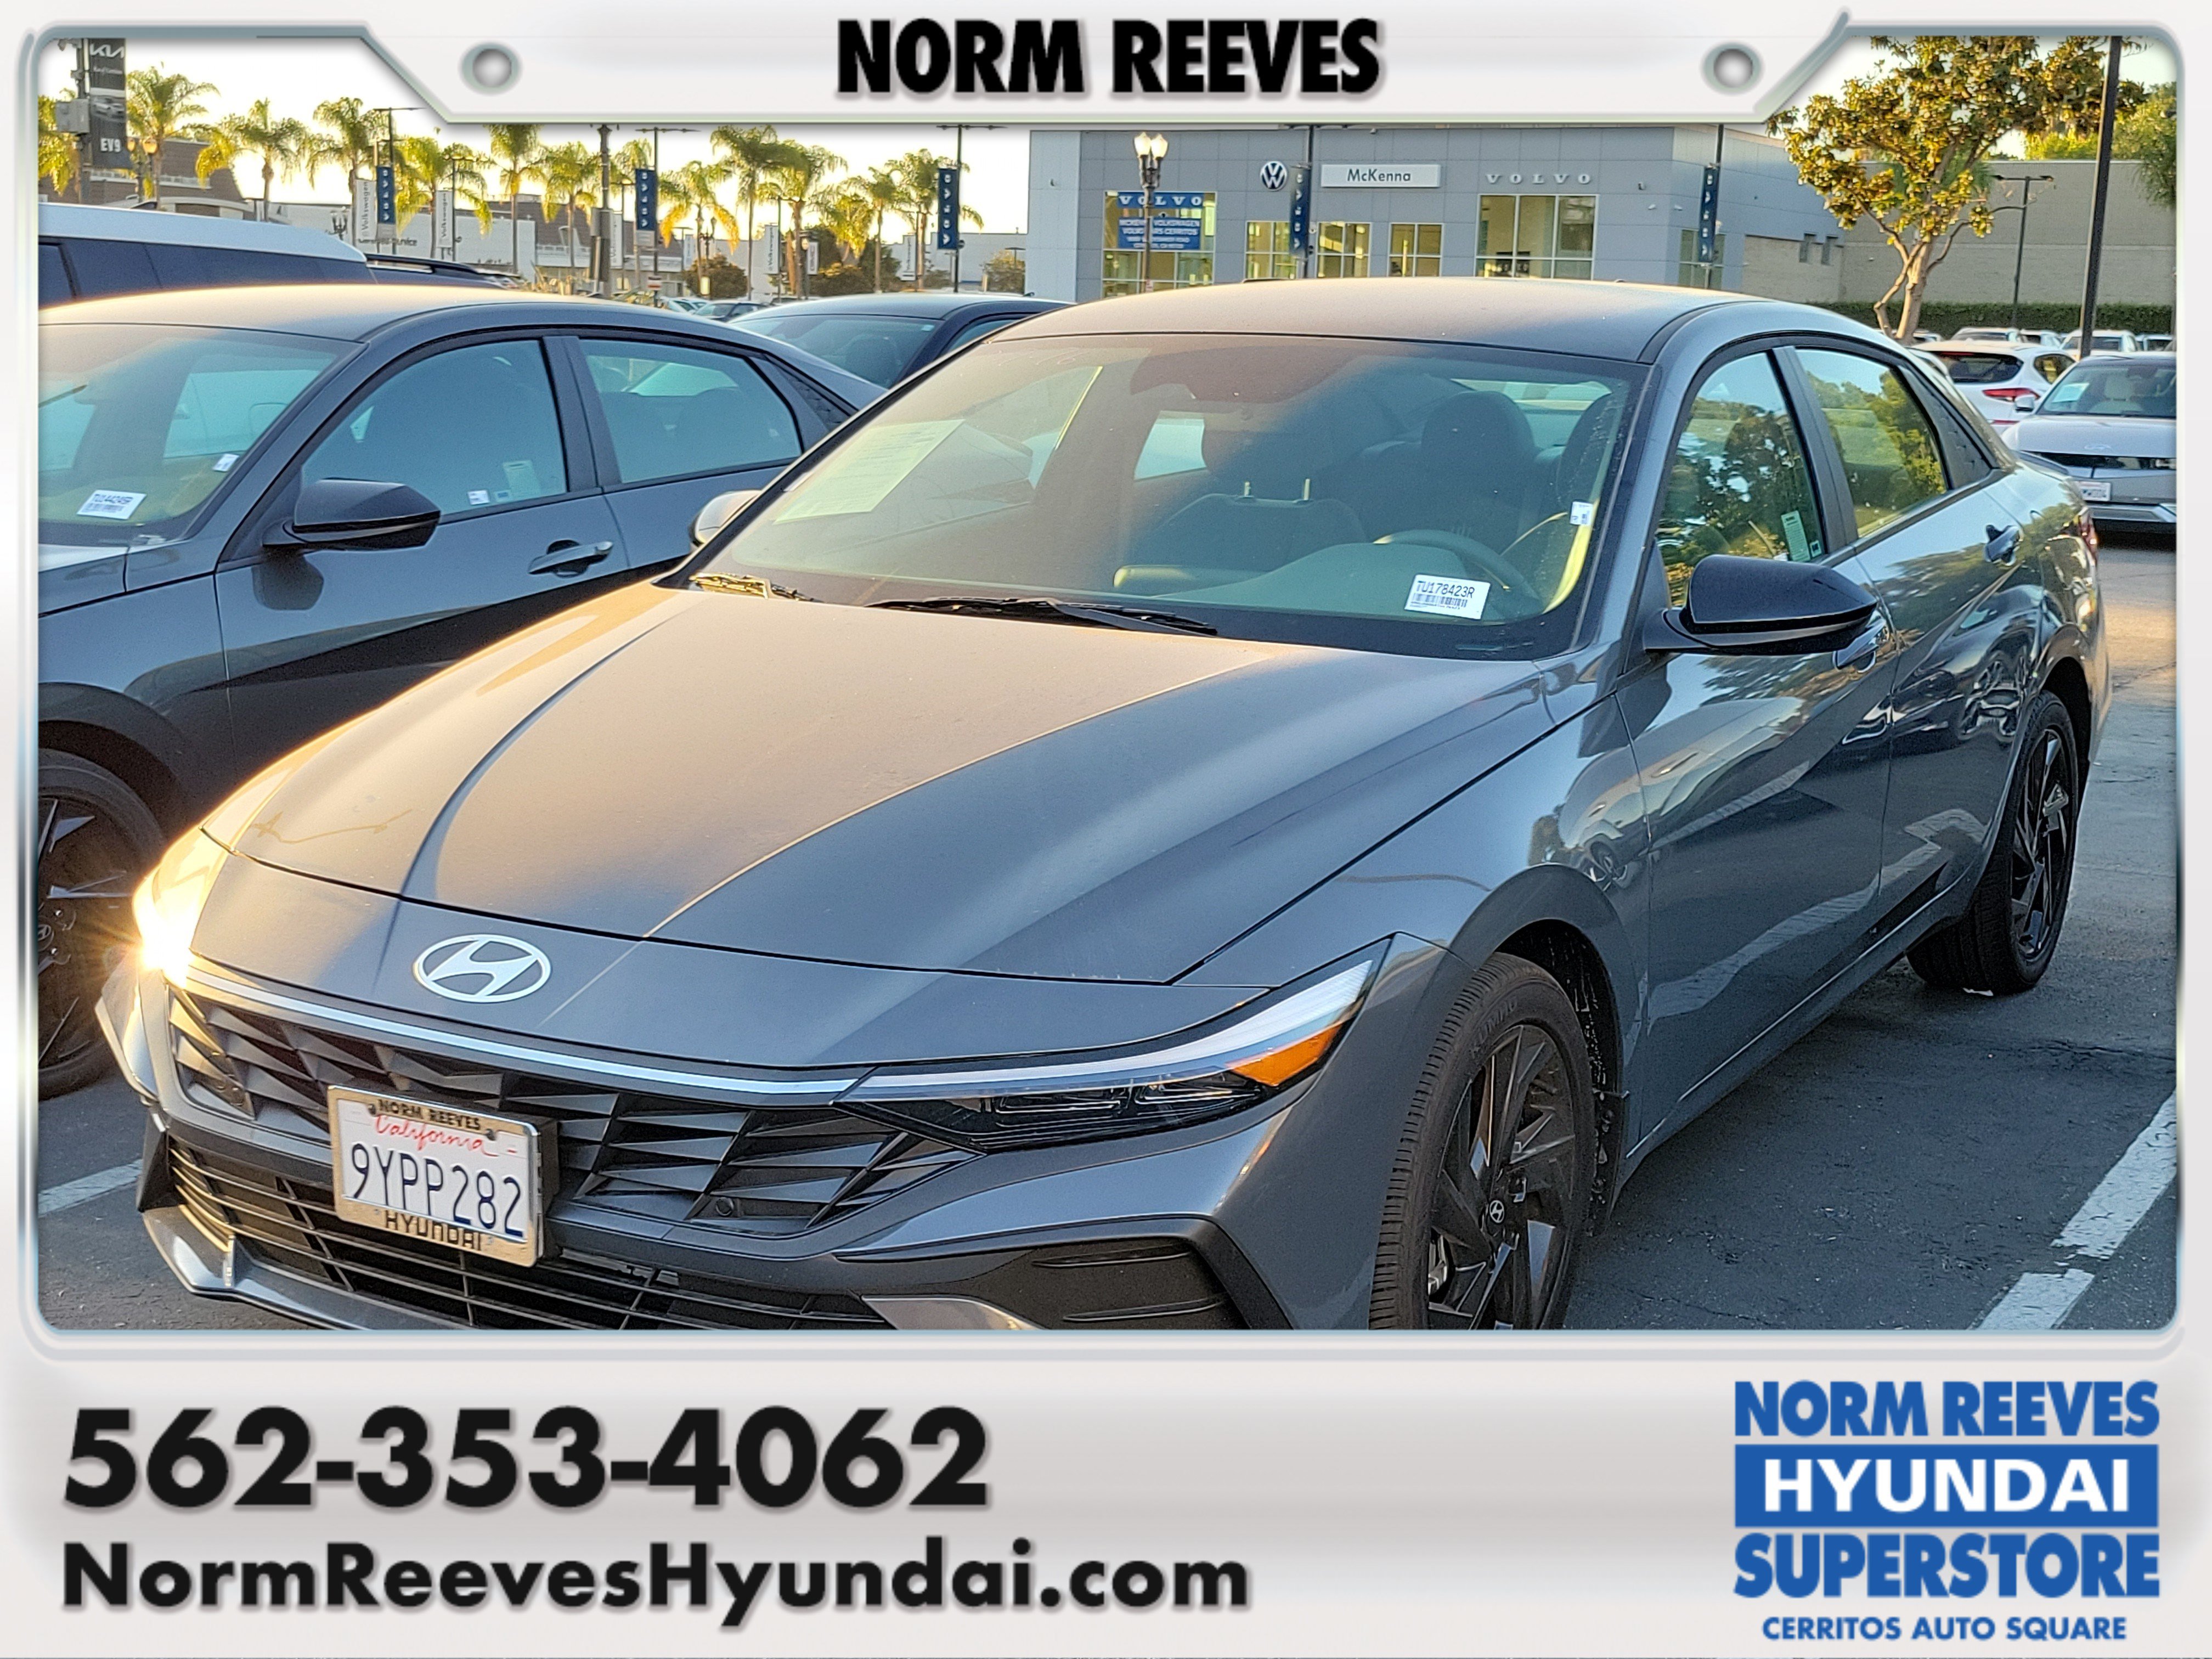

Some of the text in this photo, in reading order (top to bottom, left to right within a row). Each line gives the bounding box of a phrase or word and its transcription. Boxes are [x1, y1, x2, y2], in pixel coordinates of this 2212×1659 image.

[100, 138, 121, 153] EV9
[1347, 168, 1412, 182] McKenna
[1486, 173, 1591, 185] VOLVO
[361, 182, 370, 231] Volkswagen
[943, 173, 951, 245] VOLVO
[1119, 195, 1202, 206] VOLVO
[1416, 580, 1475, 599] TU178423R
[377, 1099, 481, 1131] NORM REEVES
[375, 1114, 499, 1156] California
[352, 1142, 523, 1238] 9YPP282
[385, 1210, 482, 1251] HYUNDAI
